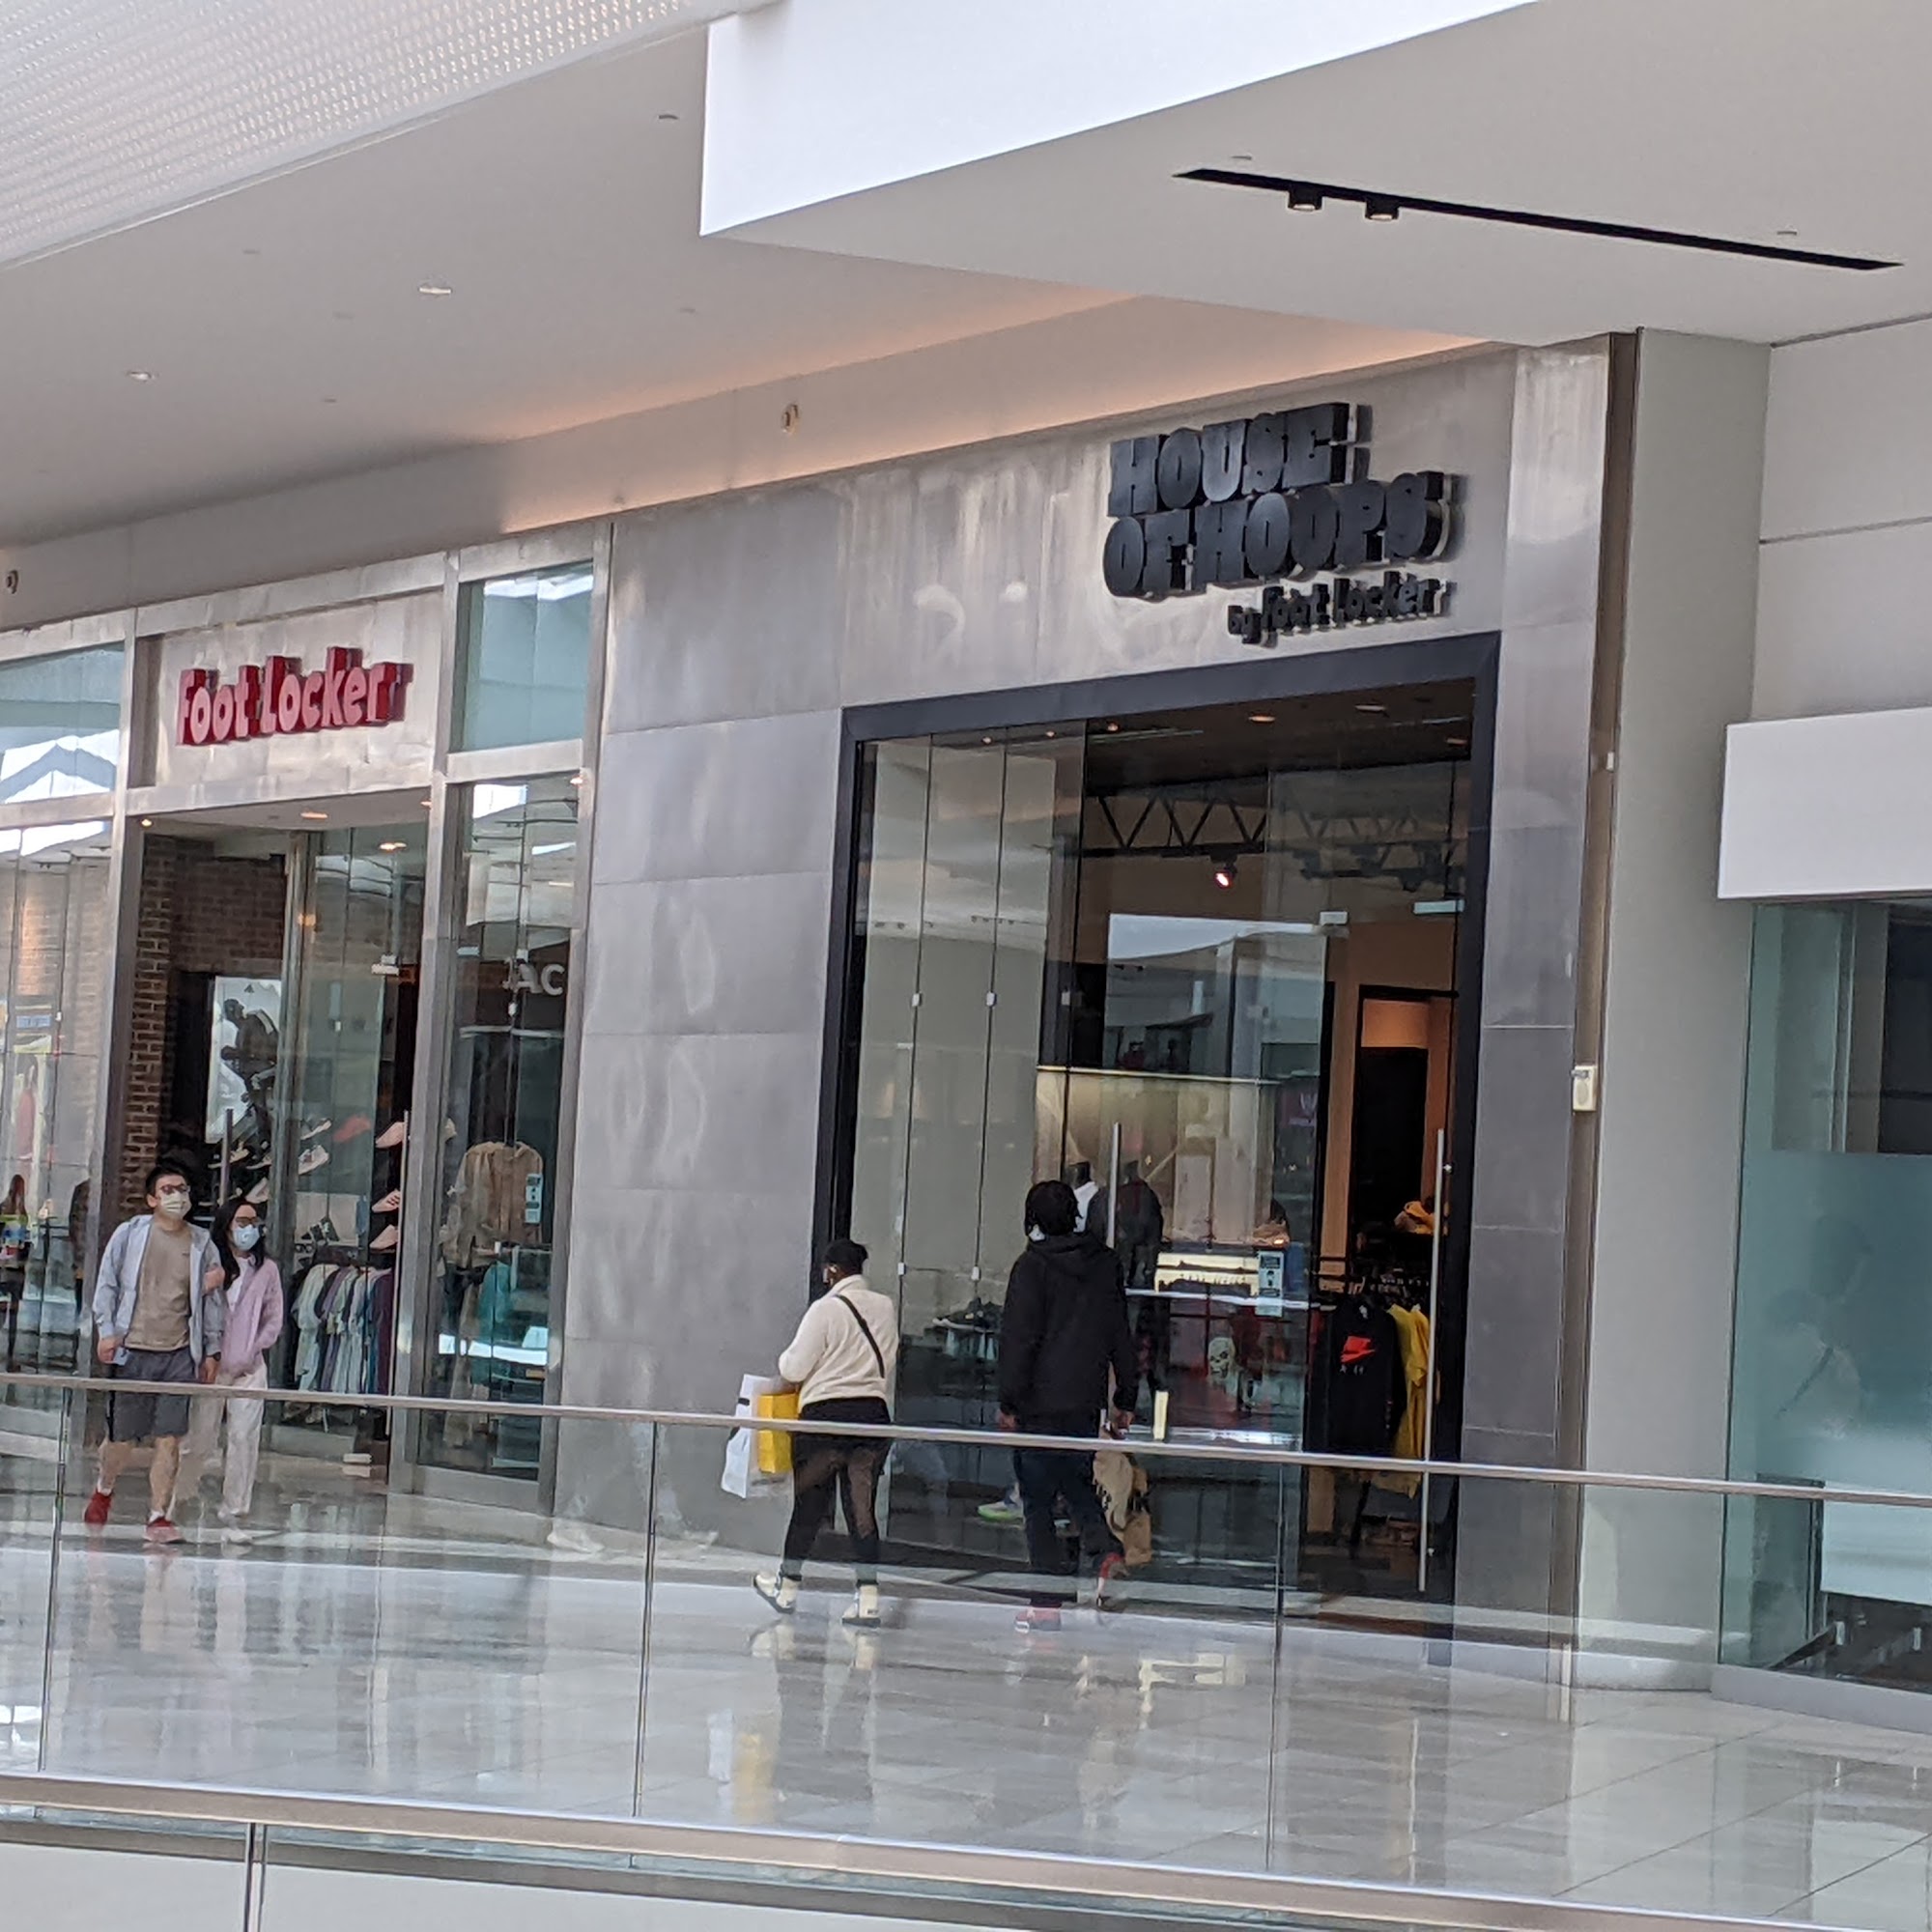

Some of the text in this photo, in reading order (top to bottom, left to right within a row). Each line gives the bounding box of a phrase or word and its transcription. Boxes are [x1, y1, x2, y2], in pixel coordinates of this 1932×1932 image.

[1108, 403, 1350, 517] HOUSE
[1102, 471, 1446, 598] OF HOOPS
[1228, 605, 1262, 644] by
[178, 647, 398, 745] Foot Locker
